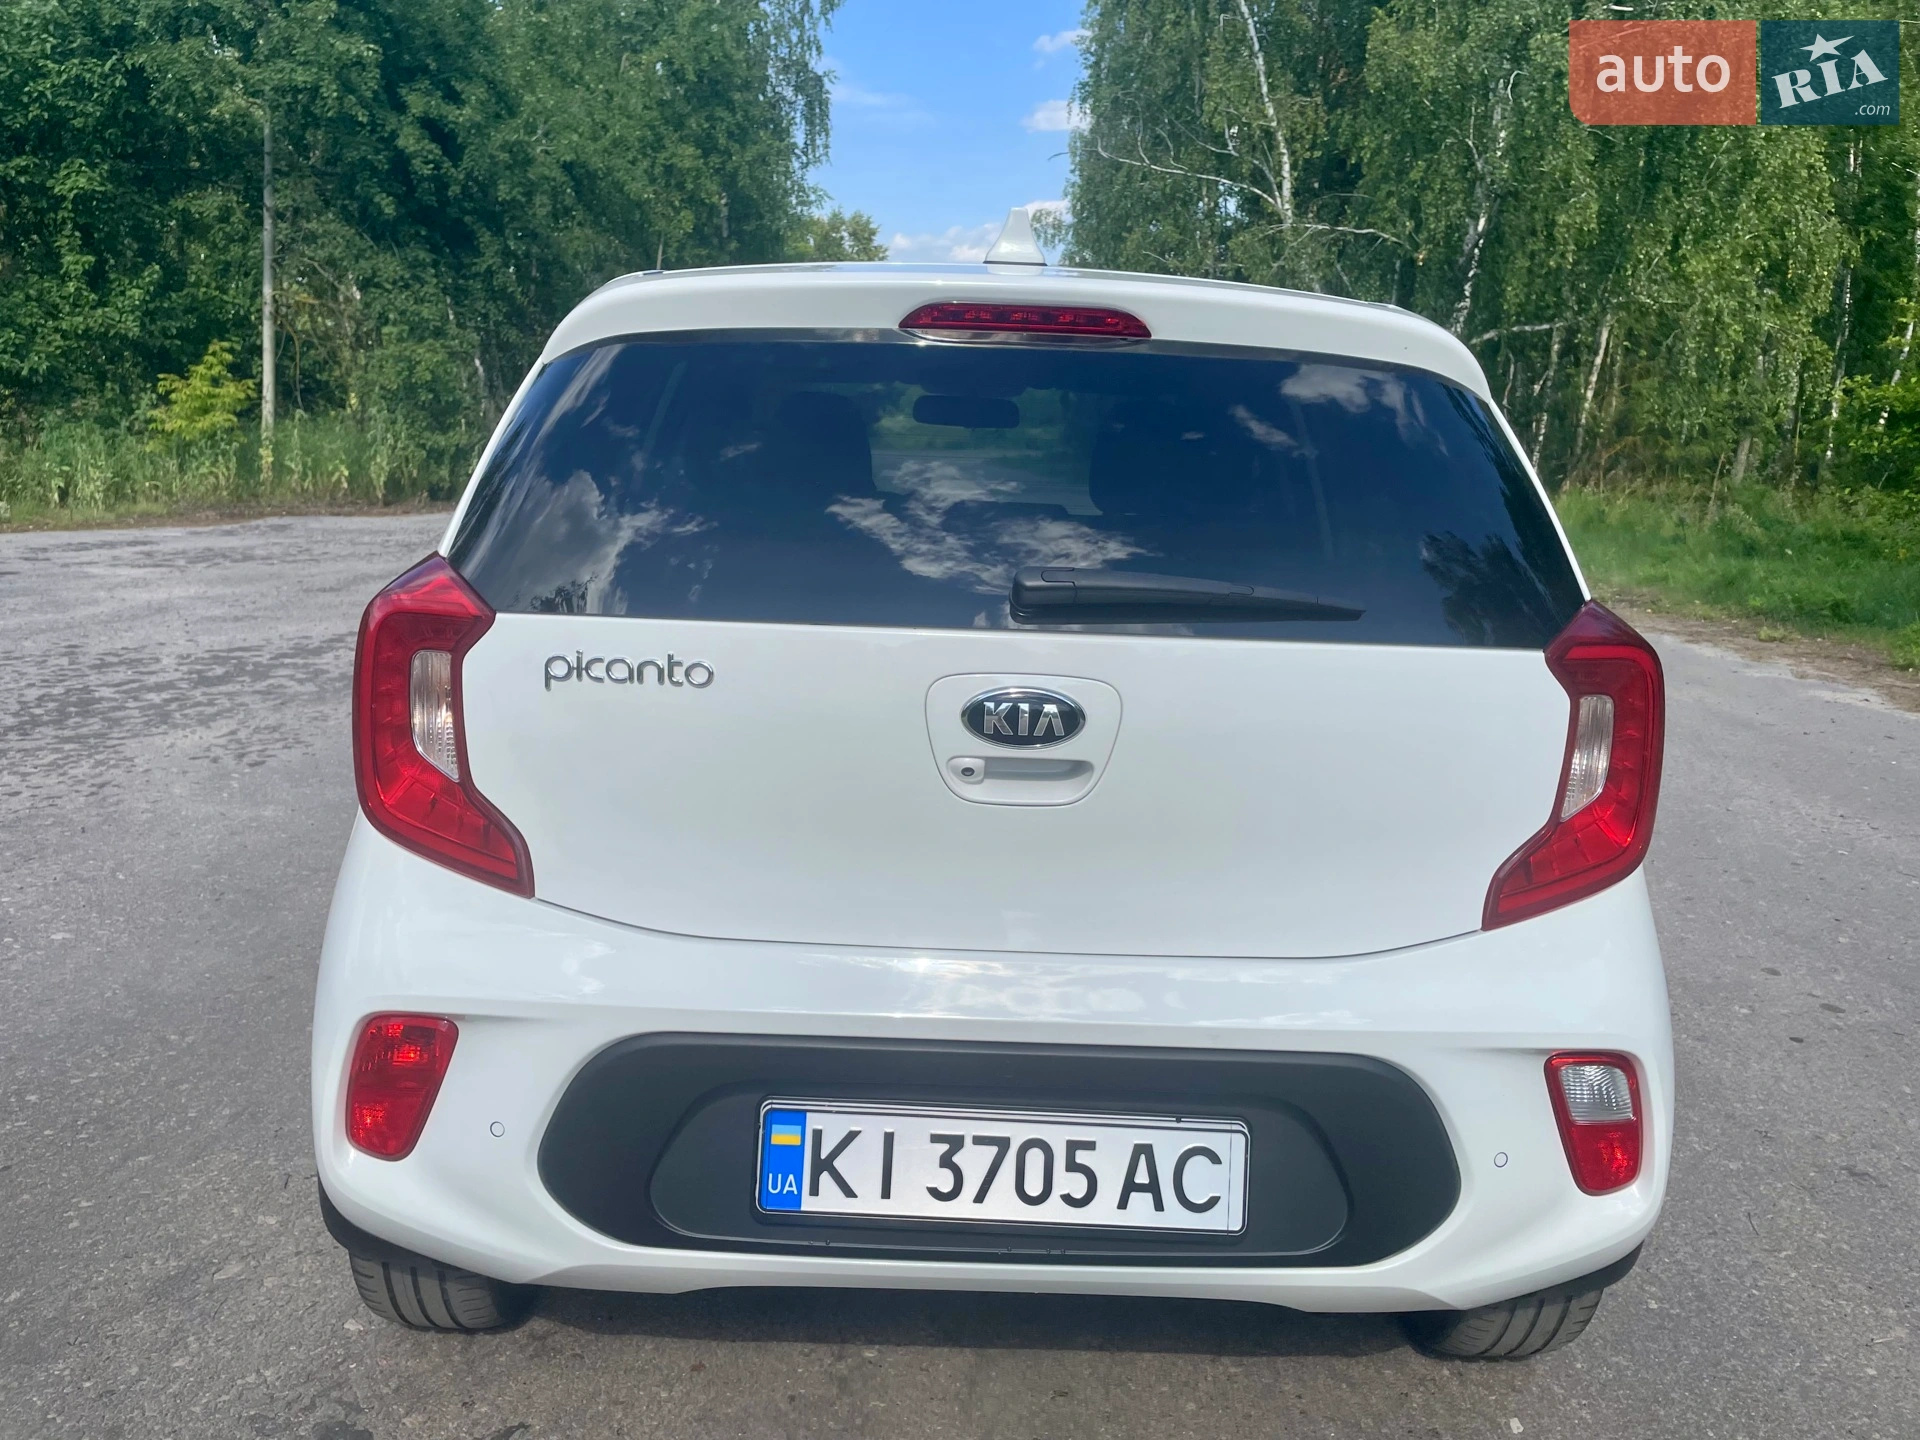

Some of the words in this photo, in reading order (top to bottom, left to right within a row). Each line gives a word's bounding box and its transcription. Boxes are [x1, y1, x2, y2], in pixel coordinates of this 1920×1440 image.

[544, 649, 715, 692] picanto
[983, 701, 1065, 736] KIA
[768, 1173, 798, 1195] UA
[808, 1127, 895, 1200] KI
[926, 1133, 1098, 1209] 3705
[1116, 1142, 1223, 1214] AC
